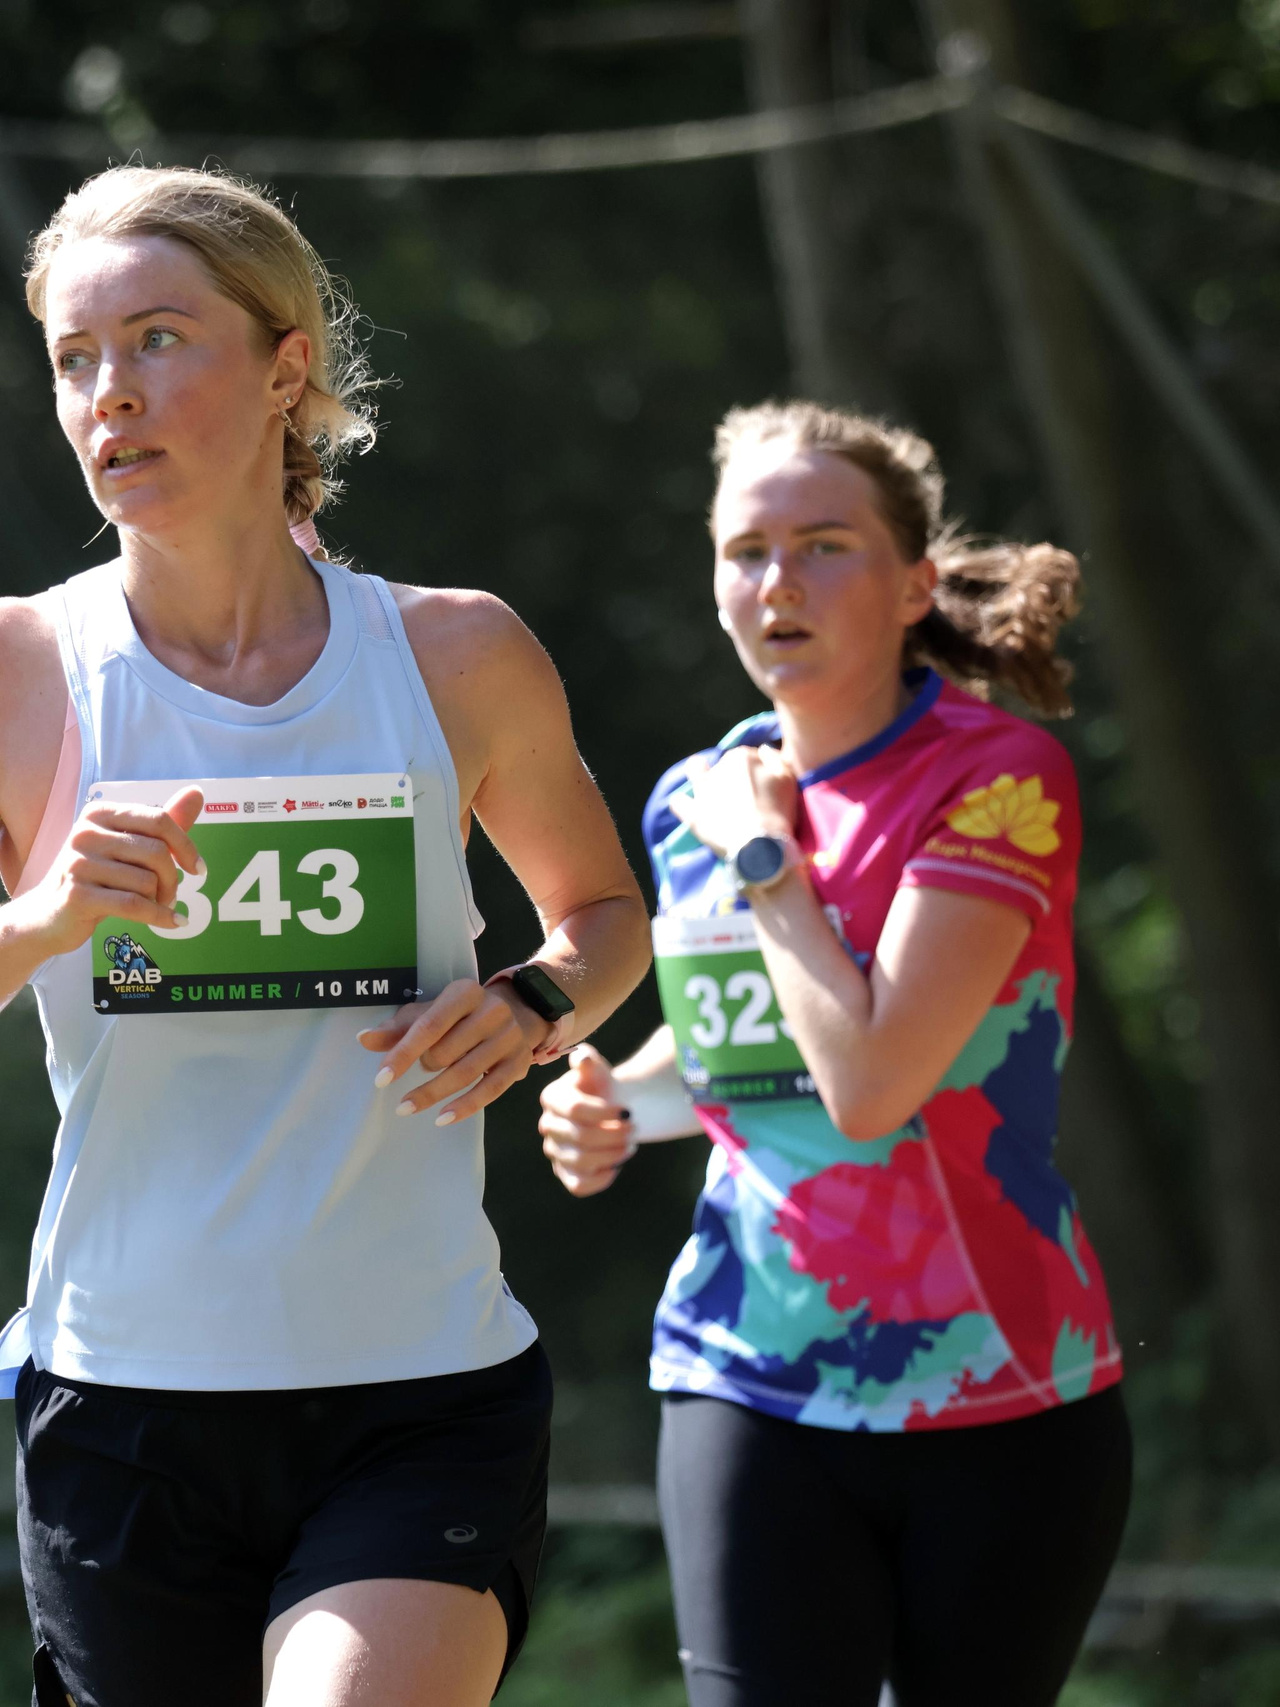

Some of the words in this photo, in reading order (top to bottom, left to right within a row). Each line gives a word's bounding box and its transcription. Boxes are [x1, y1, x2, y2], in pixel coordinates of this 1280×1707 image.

[208, 803, 236, 811] MAKFA
[108, 968, 162, 985] DAB
[114, 985, 156, 993] VERTICAL
[171, 983, 282, 1001] SUMMER
[315, 981, 342, 997] 10
[356, 979, 389, 996] KM
[684, 970, 795, 1049] 32
